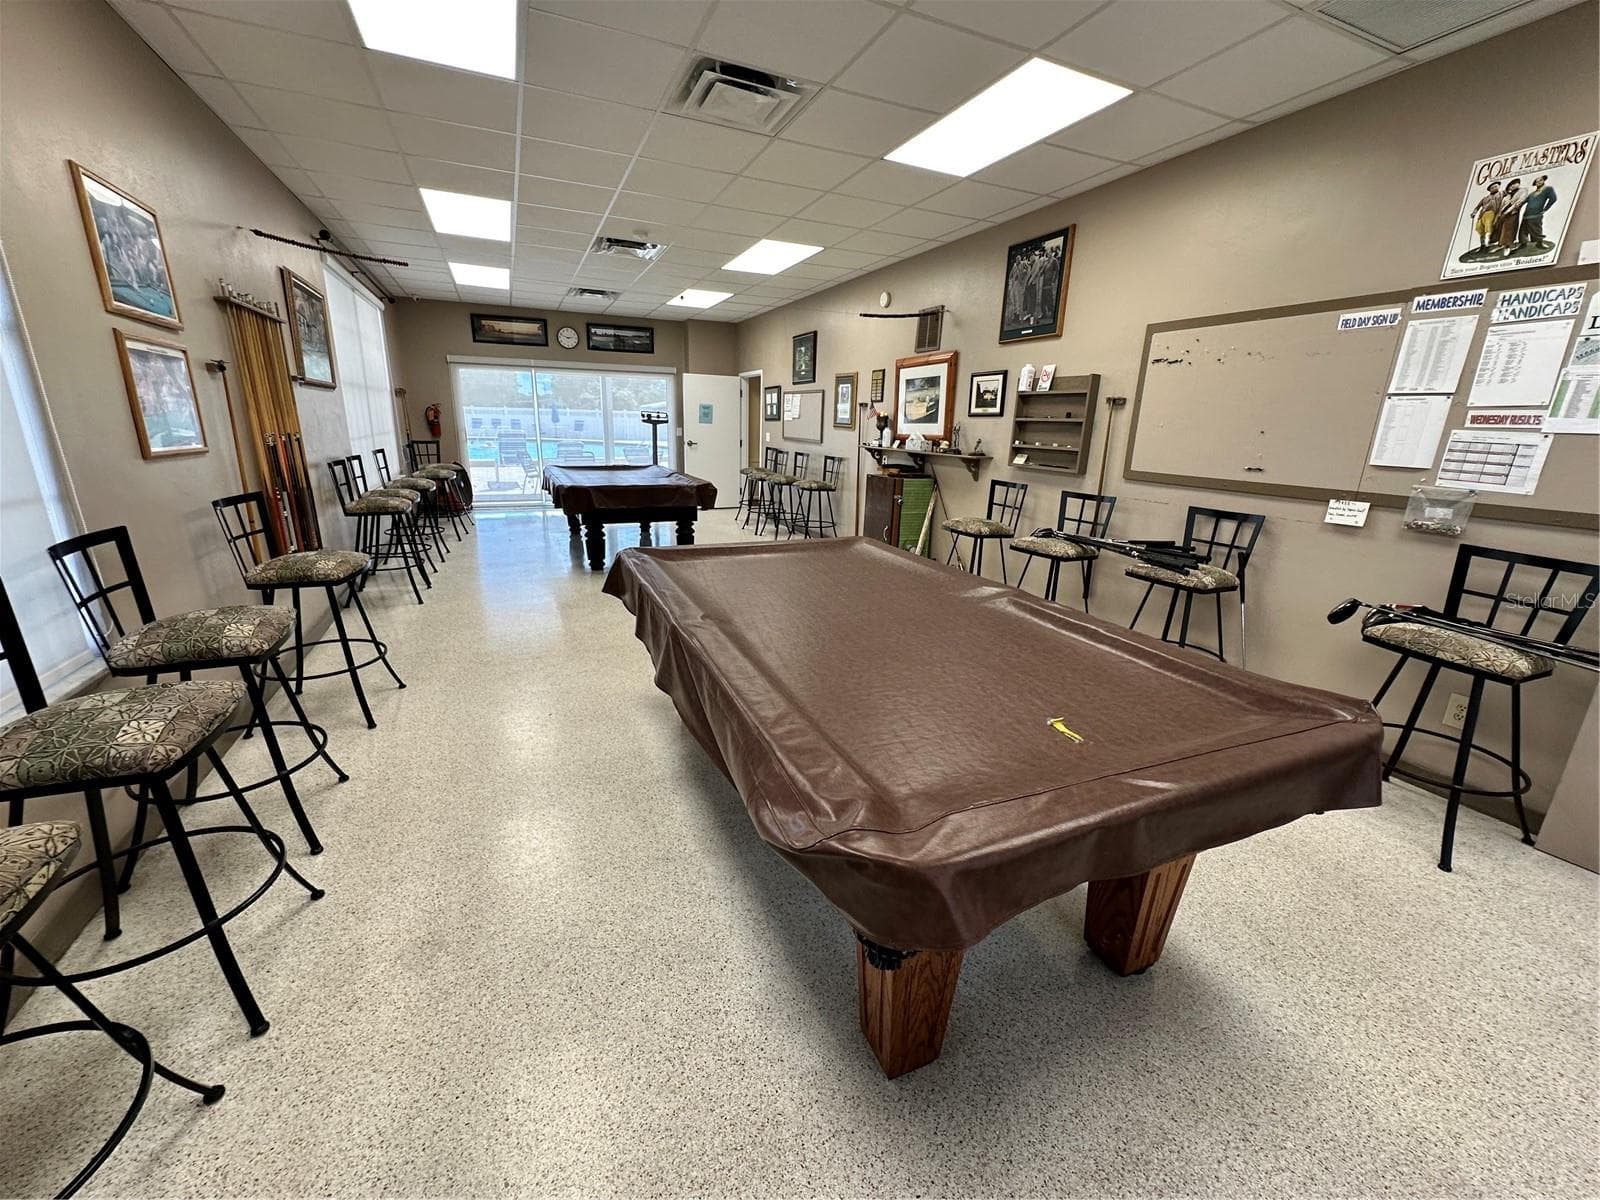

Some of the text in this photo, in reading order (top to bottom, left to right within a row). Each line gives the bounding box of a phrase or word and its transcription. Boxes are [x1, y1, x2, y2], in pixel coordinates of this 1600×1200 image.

[1477, 155, 1518, 186] GOLF
[1519, 138, 1590, 169] MASTERS
[1415, 293, 1484, 311] MEMBERSHIP
[1500, 286, 1584, 307] HANDICAPS
[1340, 313, 1399, 329] FIELD DAY SIGN UP
[1469, 414, 1510, 425] WEDNESDAY
